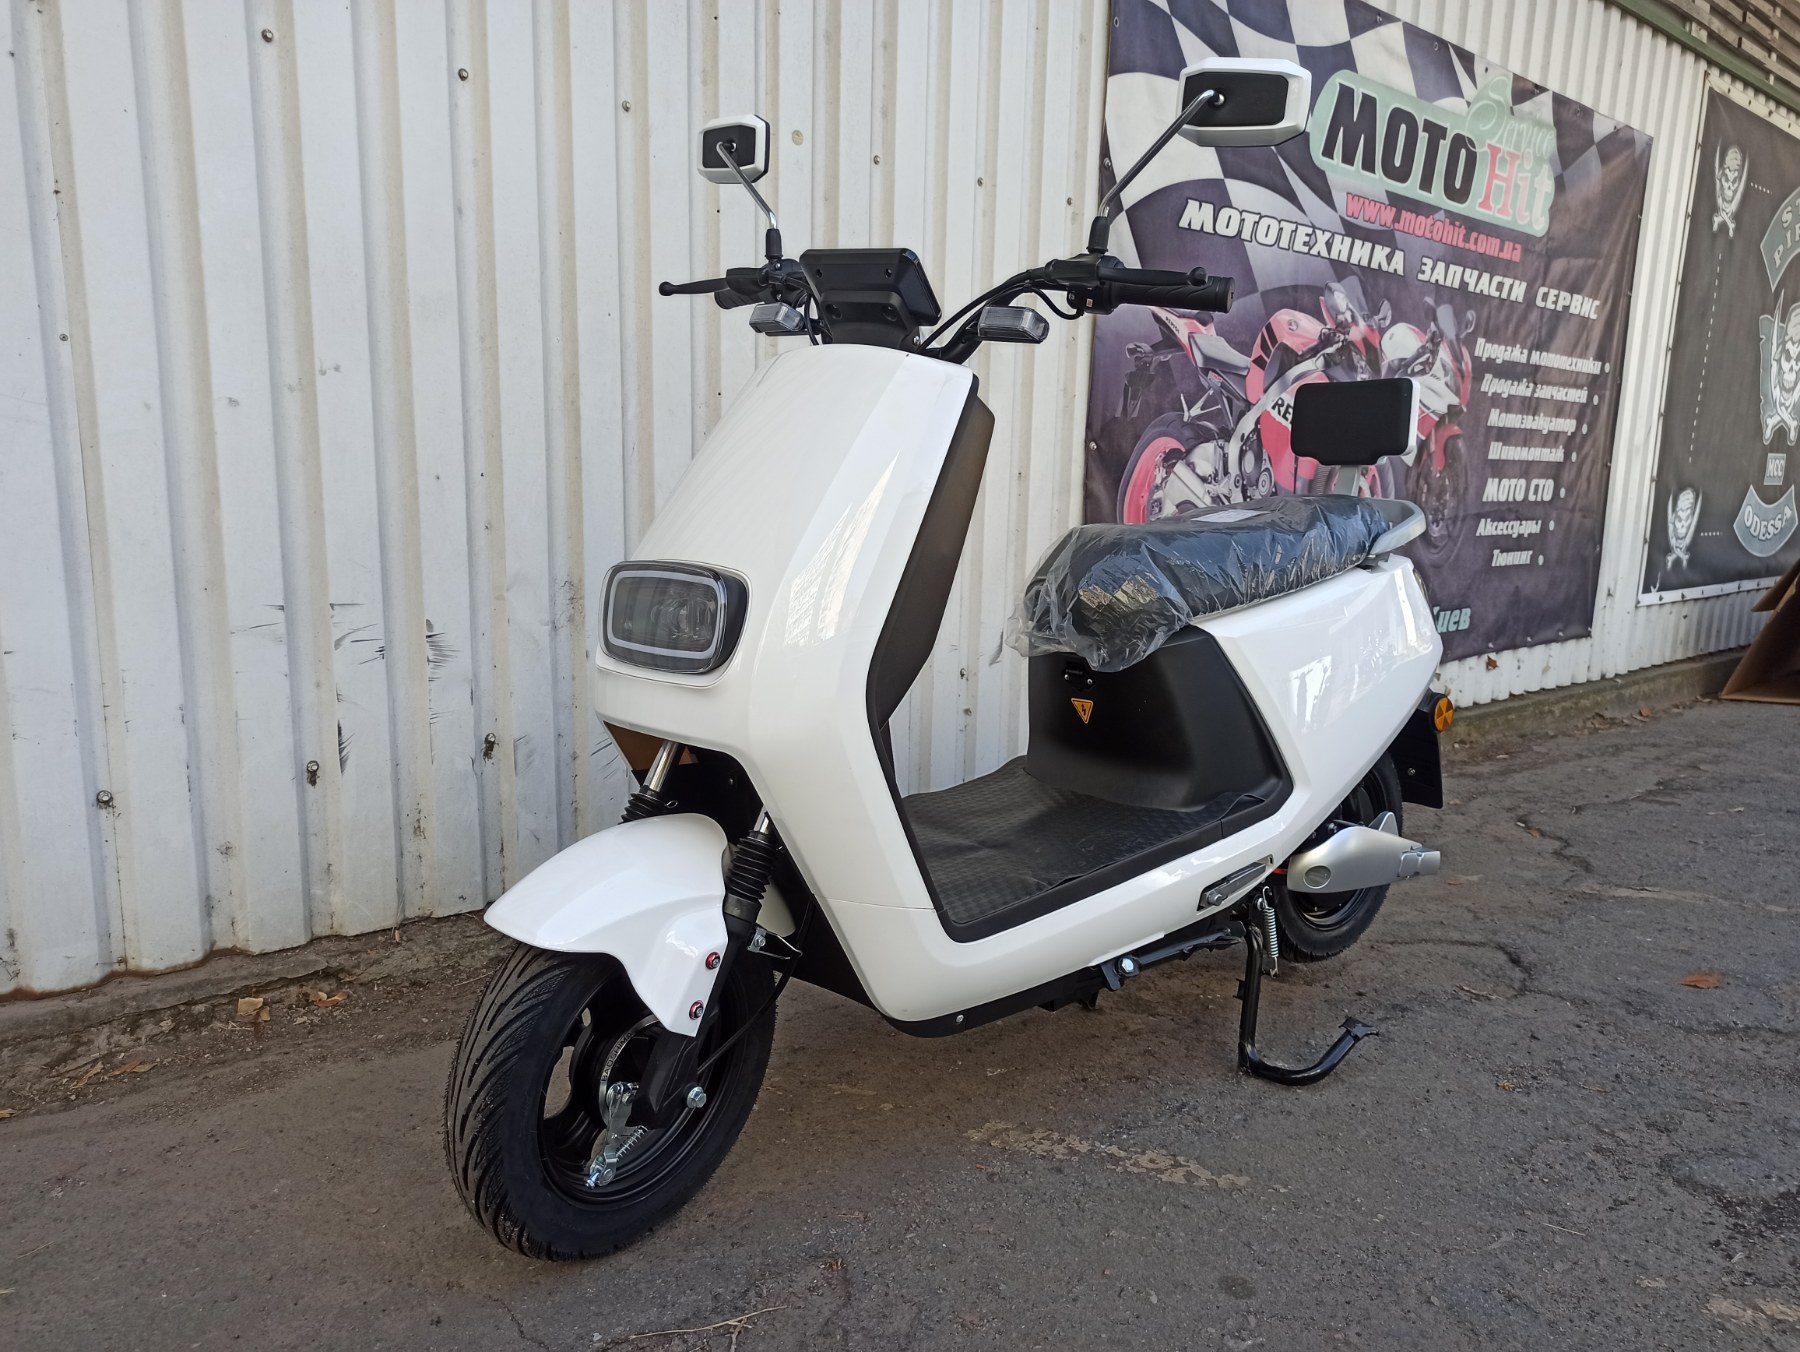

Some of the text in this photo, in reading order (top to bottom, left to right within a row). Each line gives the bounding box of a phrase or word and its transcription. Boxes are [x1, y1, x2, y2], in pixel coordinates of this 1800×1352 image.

[1465, 76, 1555, 158] Service
[1346, 192, 1522, 262] www.motohit.com.ua
[1178, 198, 1601, 320] МОТОТЕХНИКА ЗАПЧАСТИ СЕРВИС
[1474, 337, 1602, 375] Продажа мототехники
[1480, 373, 1588, 404] Продажа запчастей
[1271, 396, 1294, 424] RE
[1487, 408, 1577, 436] Мотоэвакуатор
[1487, 441, 1565, 463] Шиномонтаж
[1482, 478, 1555, 502] МОТО СТО
[1475, 518, 1542, 538] Аксессуары
[1744, 504, 1792, 541] ODESSA
[1491, 549, 1533, 567] Тюнинг
